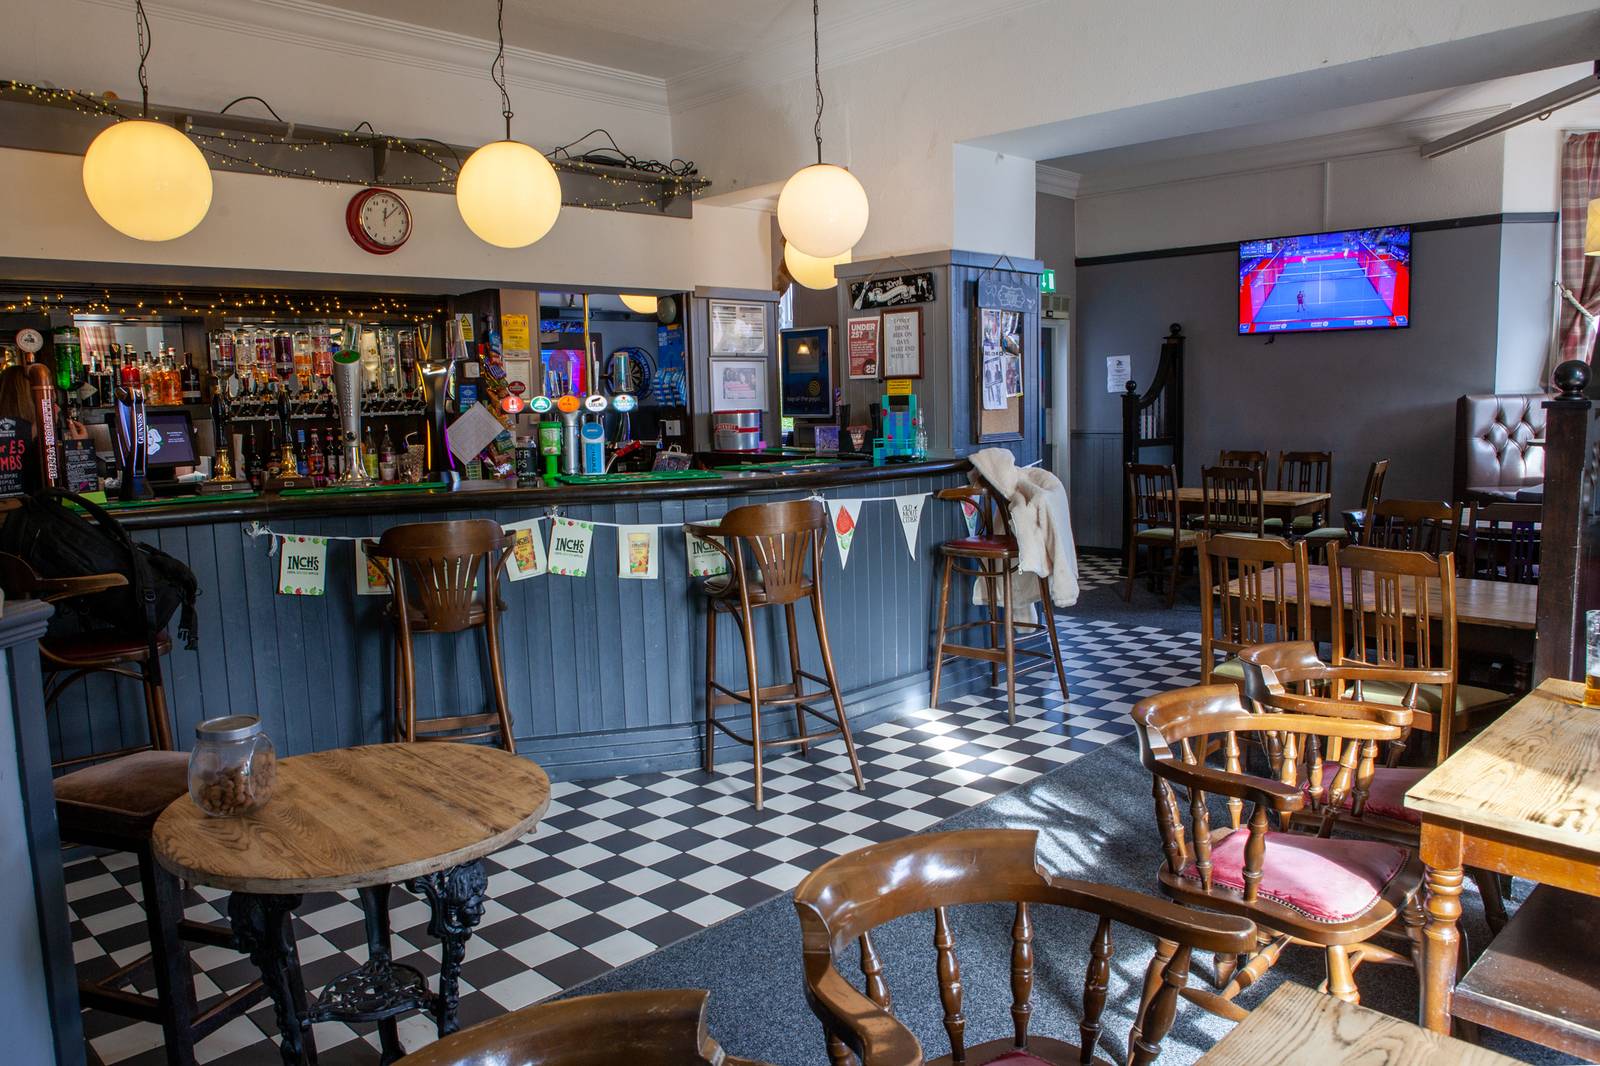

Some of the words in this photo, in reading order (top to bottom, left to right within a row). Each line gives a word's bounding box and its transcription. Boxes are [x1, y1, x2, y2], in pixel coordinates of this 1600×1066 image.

[851, 323, 876, 331] UNDER
[865, 364, 876, 374] 25
[9, 439, 25, 455] £5
[0, 455, 22, 471] MBS
